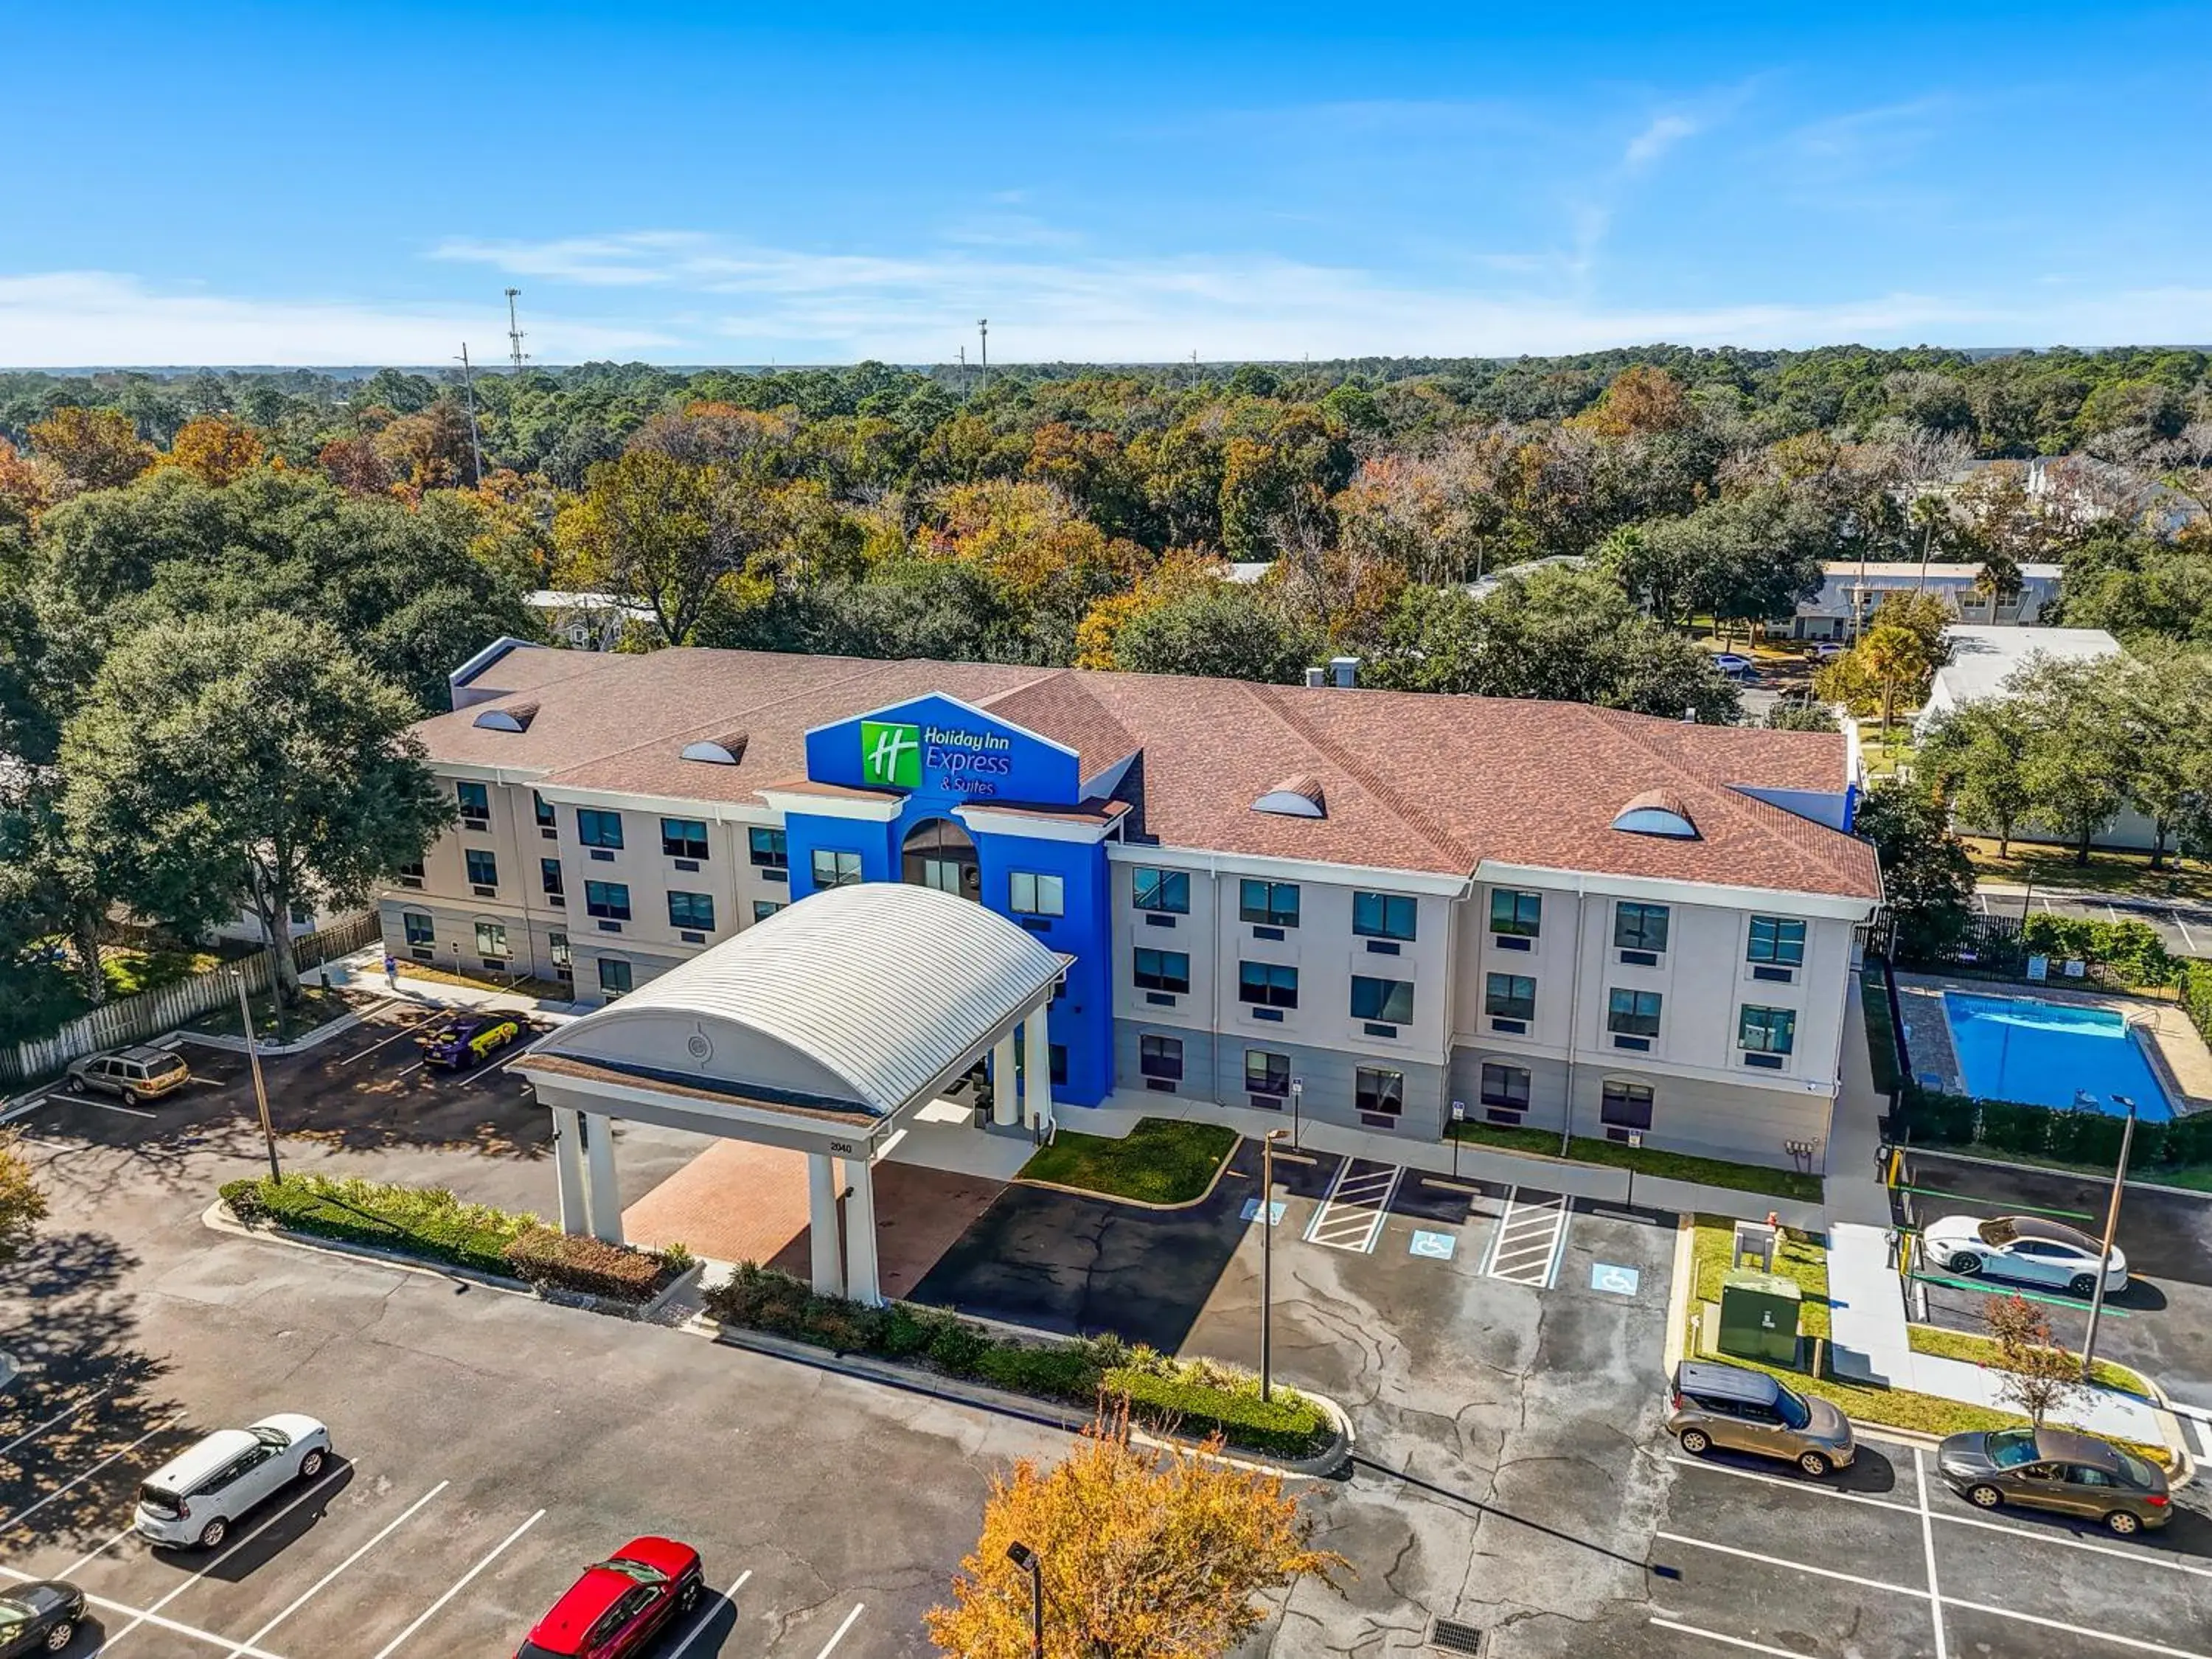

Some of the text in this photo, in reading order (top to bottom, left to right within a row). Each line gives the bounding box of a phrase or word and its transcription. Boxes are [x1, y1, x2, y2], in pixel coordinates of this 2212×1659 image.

[924, 726, 1009, 752] Holiday Inn
[925, 745, 1010, 776] Express
[940, 776, 994, 796] & Suites
[830, 1142, 852, 1153] 2040
